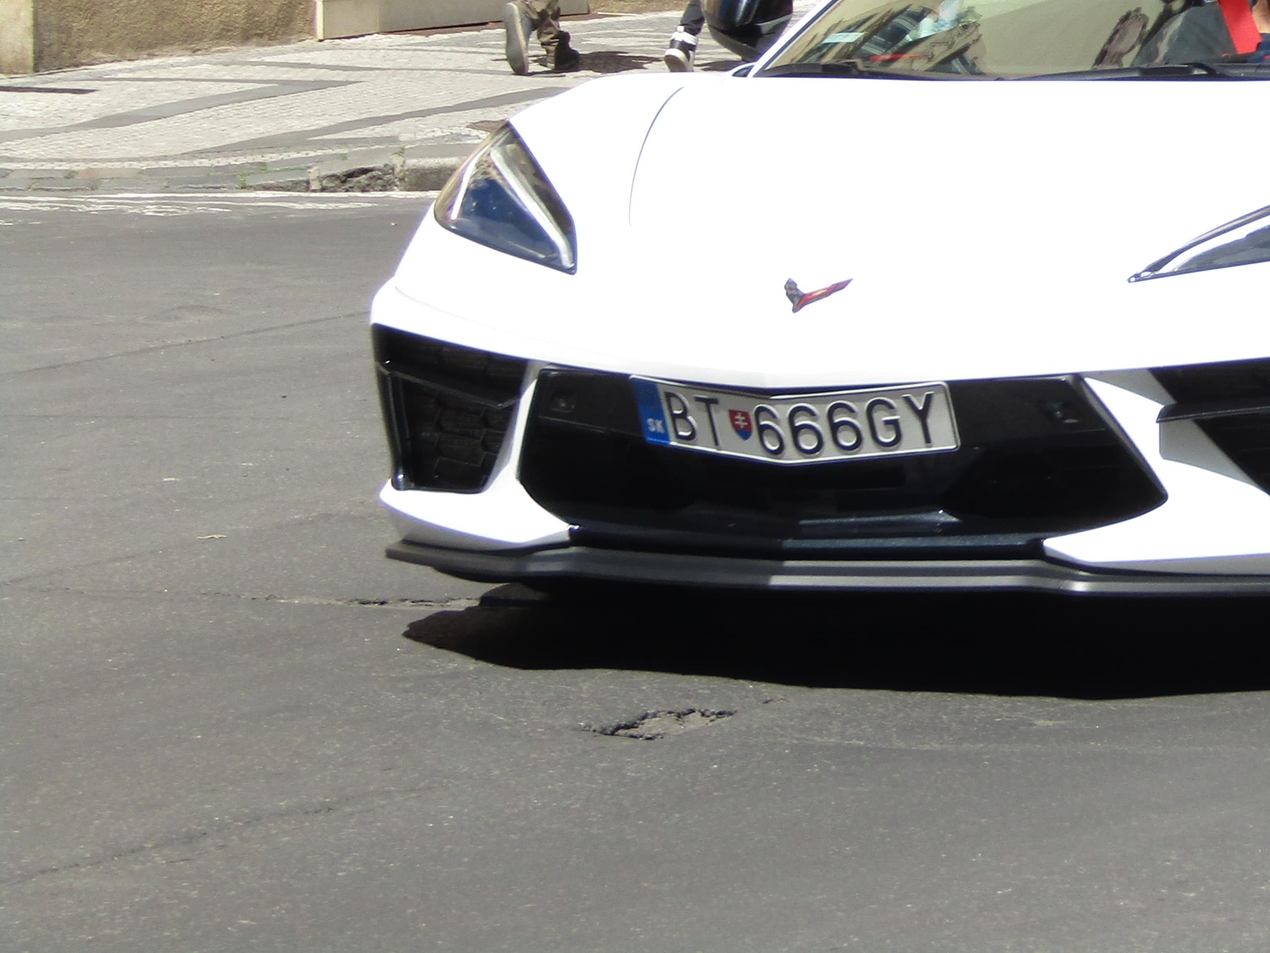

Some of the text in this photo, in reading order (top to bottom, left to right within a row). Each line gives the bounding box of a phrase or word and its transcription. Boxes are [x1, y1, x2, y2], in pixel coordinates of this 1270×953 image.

[646, 418, 666, 434] SK
[664, 390, 935, 456] BT 666GY
